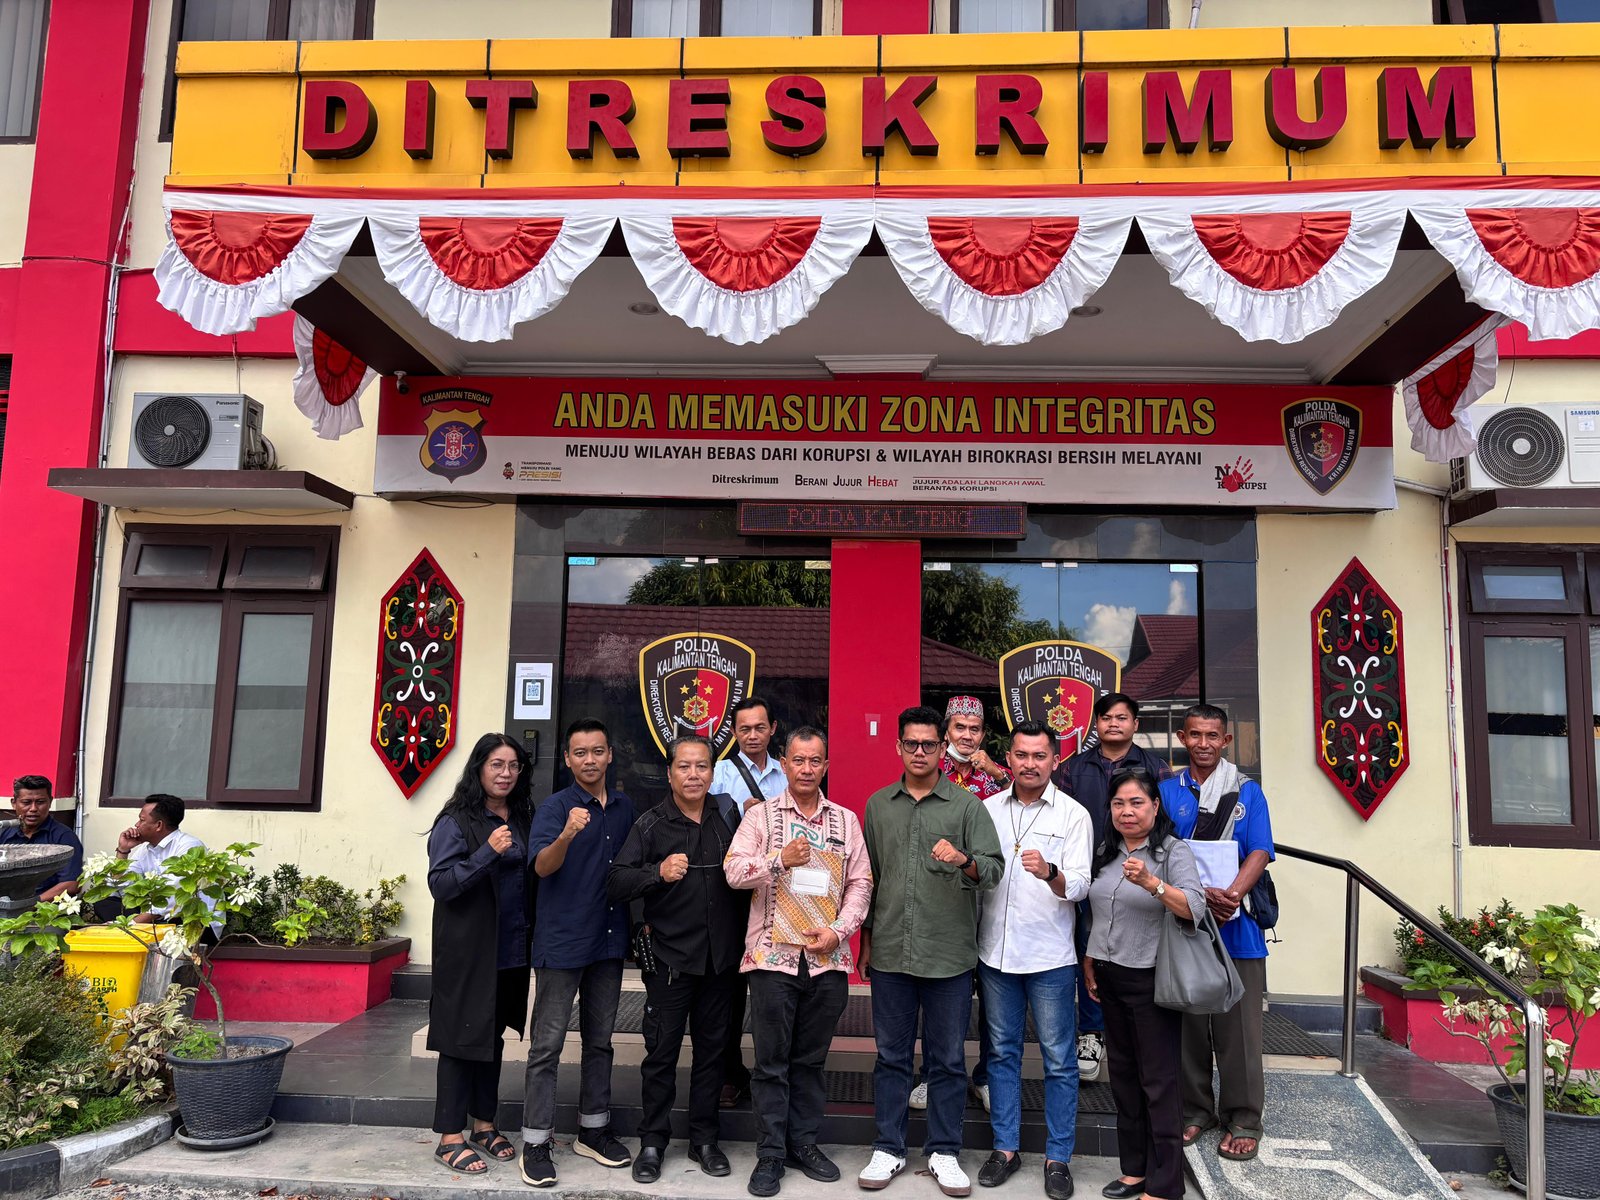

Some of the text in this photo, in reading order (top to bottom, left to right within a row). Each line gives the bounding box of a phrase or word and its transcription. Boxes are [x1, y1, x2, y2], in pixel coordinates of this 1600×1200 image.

[301, 65, 1476, 160] DITRESKRIMUM
[422, 391, 491, 405] KALIMANTAN TENGAH
[1305, 401, 1337, 413] POLDA
[553, 392, 1218, 436] ANDA MEMASUKI ZONA INTEGRITAS
[1293, 411, 1350, 428] KALIMANTAN TENGAH
[565, 444, 1202, 466] MENUJU WILAYAH BEBAS DARI KORUPSI & WILAYAH BIROKRASI BERSIH MELAYANI
[1288, 428, 1318, 482] DIREKTORAT RESERSE
[1328, 429, 1355, 482] KRIMINAL UMUM
[519, 471, 562, 479] PRESISI
[712, 474, 899, 487] Ditreskrimum BERANI JUJUR HEBAT
[787, 509, 855, 526] POLDA
[674, 638, 720, 655] POLDA
[1035, 646, 1084, 664] POLDA
[656, 652, 738, 679] KALIMANTAN TENGAH
[1017, 660, 1102, 688] KALIMANTAN TENGAH
[649, 680, 665, 730] DIREKTORAT
